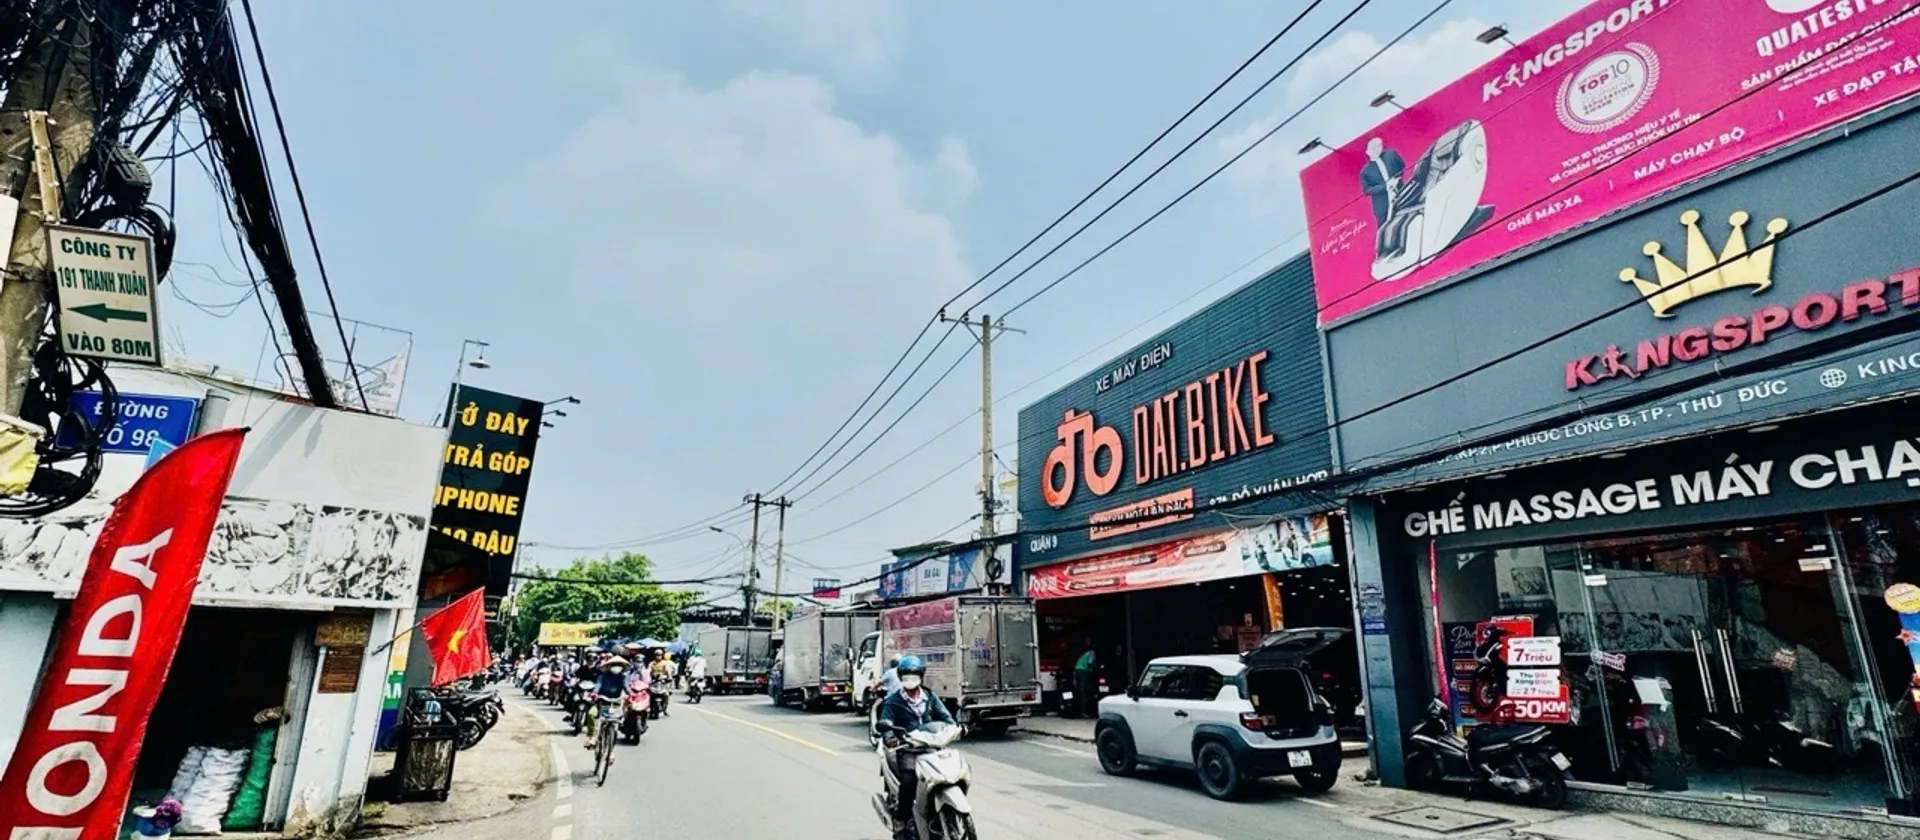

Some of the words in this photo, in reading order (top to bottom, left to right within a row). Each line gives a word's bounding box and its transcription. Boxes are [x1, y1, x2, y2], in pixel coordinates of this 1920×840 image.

[1578, 74, 1609, 94] TOP
[1611, 59, 1630, 78] 10
[1507, 212, 1533, 232] GHẾ
[1633, 158, 1666, 180] MÁY
[1670, 138, 1715, 165] CHẠY
[1719, 126, 1745, 147] BỘ
[1813, 88, 1839, 108] XE
[1842, 70, 1887, 95] ĐẠP
[1890, 55, 1920, 75] TẬ
[61, 238, 111, 260] CÔNG
[116, 245, 137, 261] TY
[58, 266, 77, 289] 191
[80, 270, 117, 293] THANH
[118, 271, 148, 297] XUÂN
[67, 333, 105, 352] VÀO
[112, 338, 152, 357] 80M
[1096, 375, 1110, 394] XE
[1113, 358, 1137, 384] MÁY
[1141, 342, 1171, 371] ĐIỆN
[1679, 391, 1722, 414] THỦ
[1739, 379, 1788, 403] ĐỨC
[461, 401, 479, 426] Ở
[485, 411, 529, 436] ĐÂY
[1133, 350, 1274, 487] DAT.BIKE
[131, 428, 160, 447] 98
[444, 443, 484, 469] TRẢ
[488, 450, 531, 475] GÓP
[434, 484, 520, 516] IPHONE
[1405, 491, 1466, 537] GHẾ
[1473, 478, 1660, 531] MASSAGE
[1671, 452, 1774, 506] MÁY
[1790, 437, 1920, 490] CHẠ
[1030, 536, 1051, 553] QUẬN
[1052, 535, 1057, 548] 9
[1514, 648, 1524, 662] 7
[1525, 653, 1552, 662] Triệu
